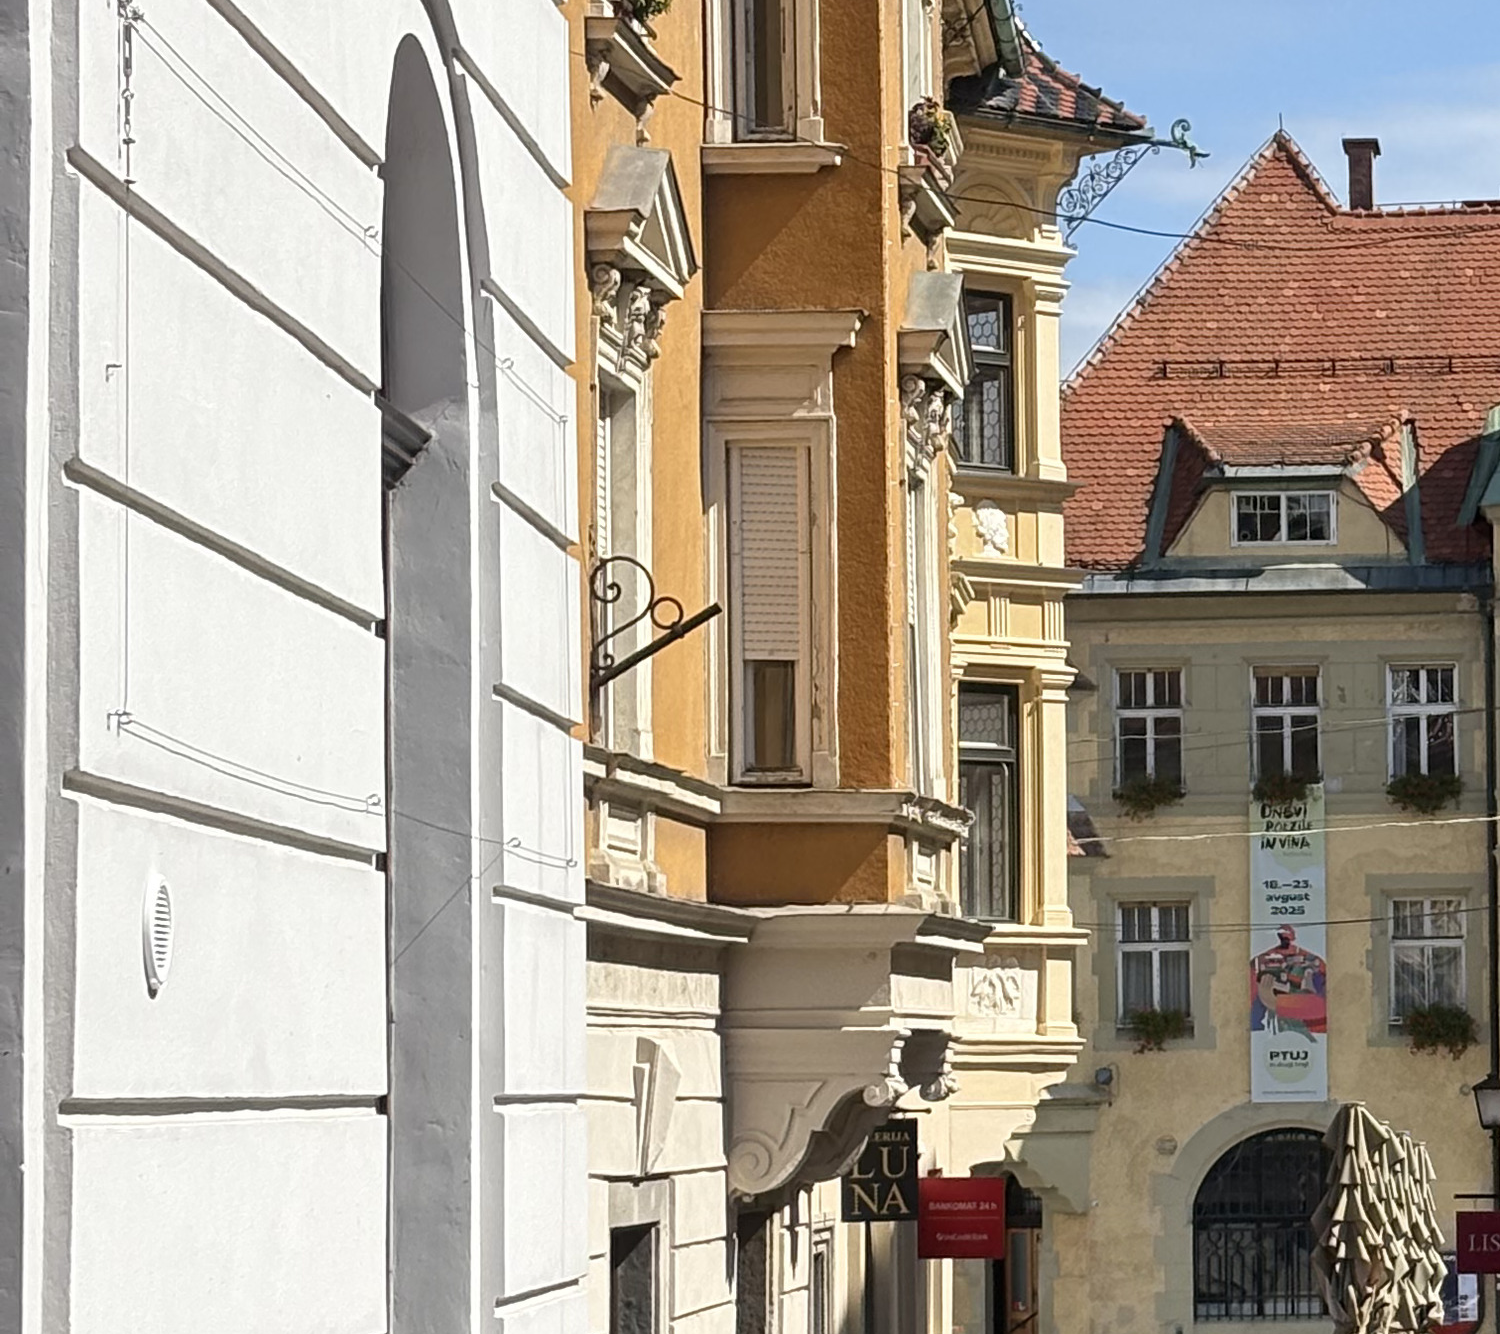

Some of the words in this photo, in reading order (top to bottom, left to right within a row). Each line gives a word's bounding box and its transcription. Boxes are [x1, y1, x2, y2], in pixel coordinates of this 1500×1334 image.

[1265, 893, 1311, 904] avgust
[1269, 1050, 1309, 1061] PTUJ
[871, 1131, 910, 1141] ERIJA
[850, 1182, 910, 1215] NA
[928, 1201, 978, 1211] BANKOMAT
[979, 1202, 990, 1210] 24
